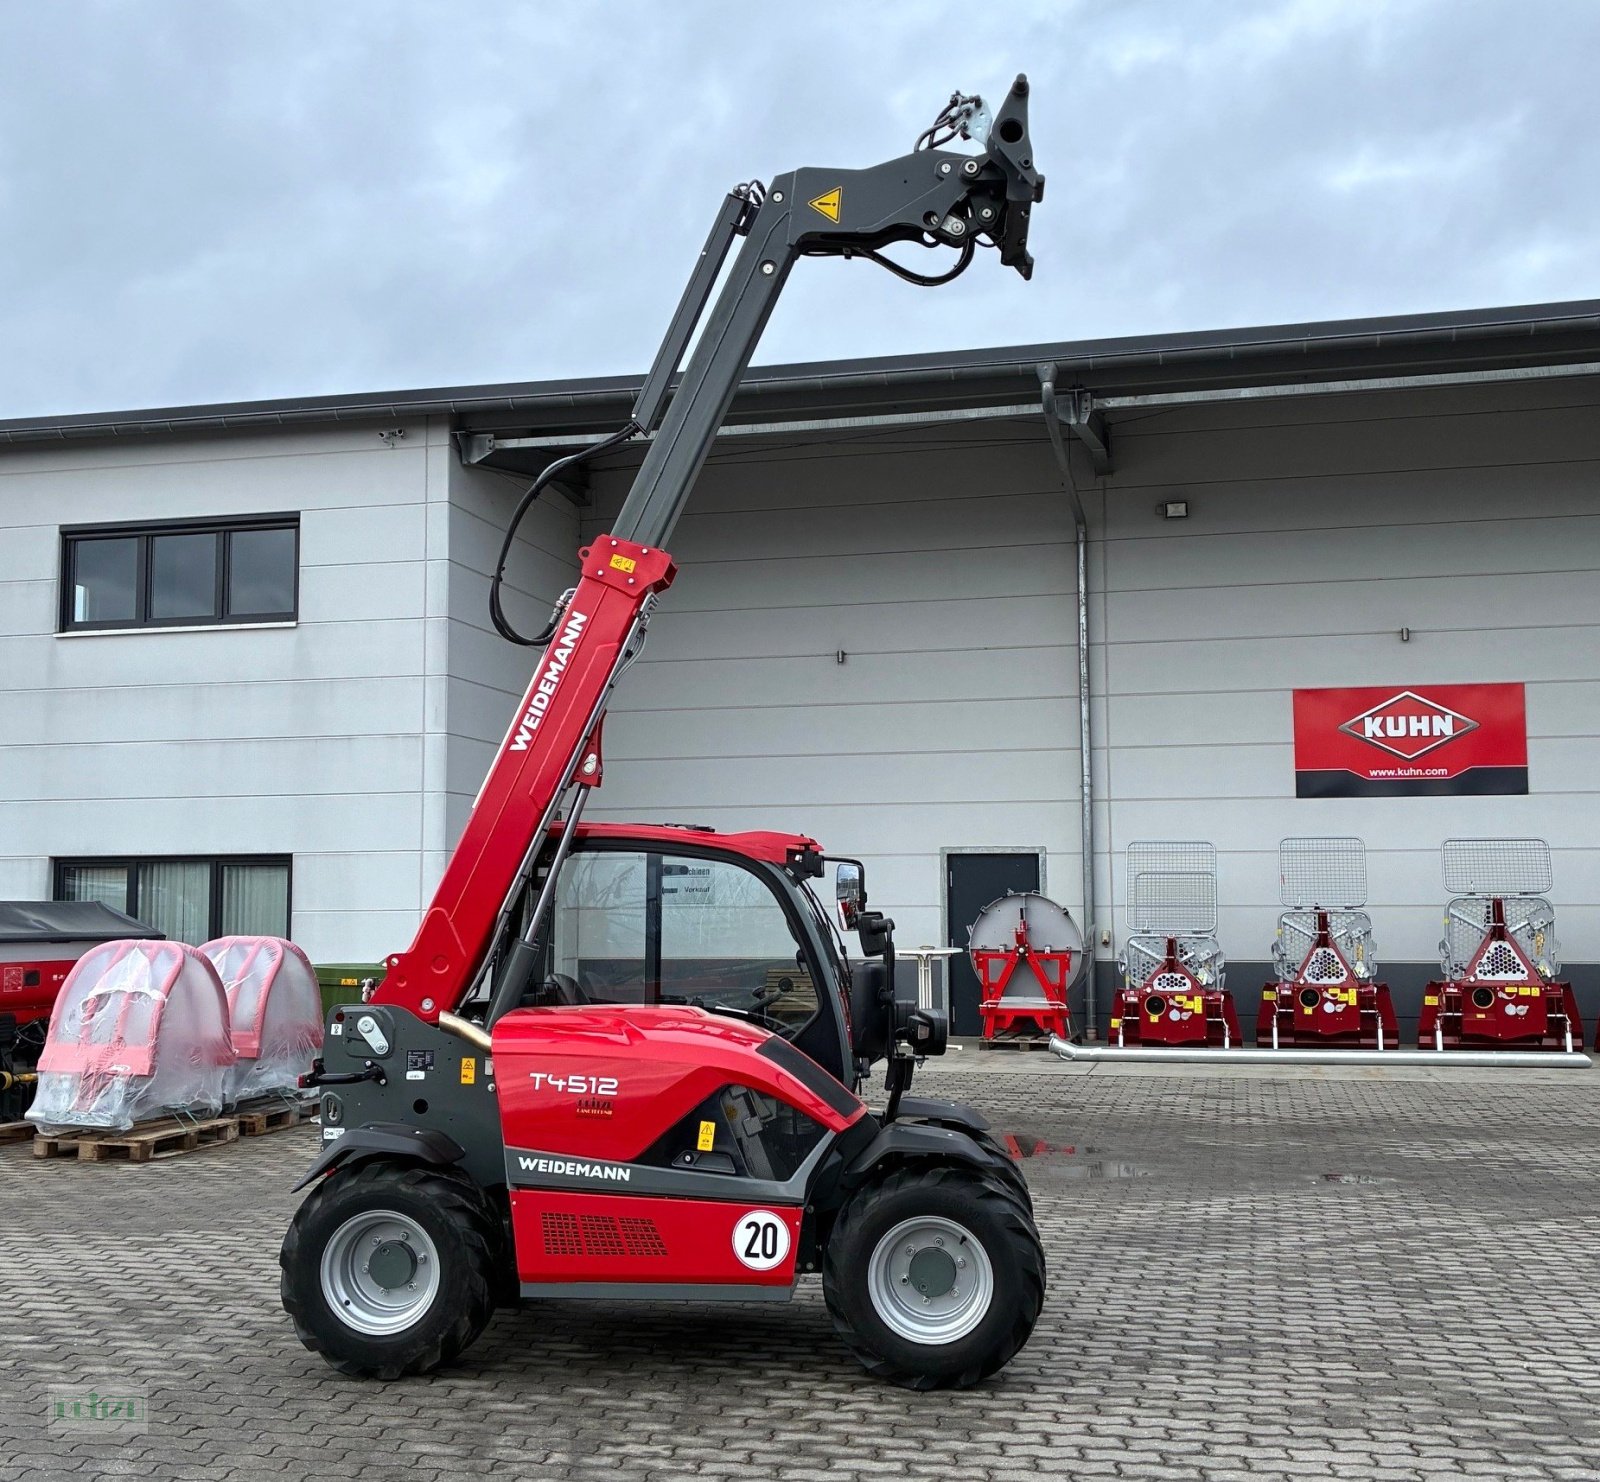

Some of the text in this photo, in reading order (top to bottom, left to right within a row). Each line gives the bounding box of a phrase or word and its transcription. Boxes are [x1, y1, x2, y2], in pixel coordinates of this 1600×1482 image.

[510, 611, 588, 751] WEIDEMANN
[1364, 715, 1453, 738] KUHN
[1369, 767, 1447, 777] www.kuhn.com
[529, 1072, 619, 1096] T4512
[518, 1156, 631, 1182] WEIDEMANN
[744, 1221, 778, 1259] 20
